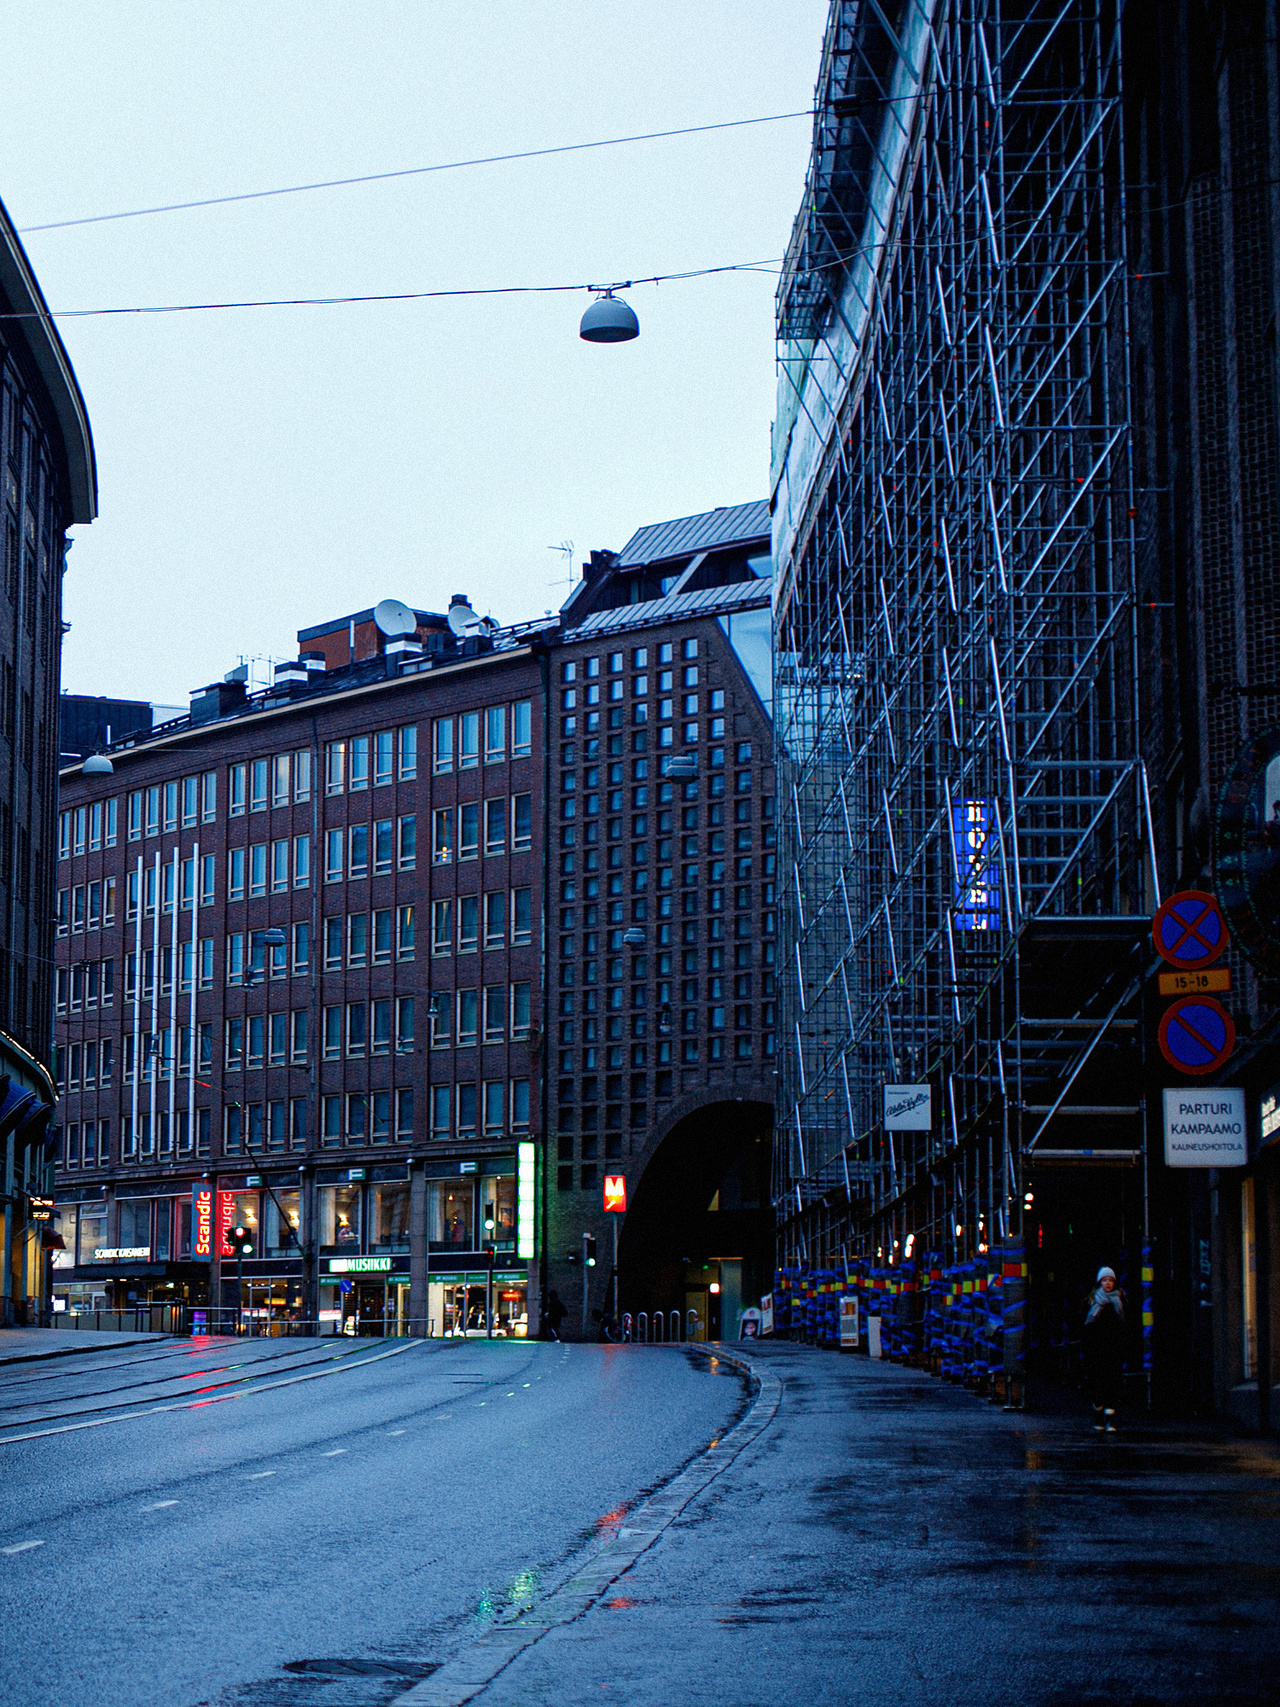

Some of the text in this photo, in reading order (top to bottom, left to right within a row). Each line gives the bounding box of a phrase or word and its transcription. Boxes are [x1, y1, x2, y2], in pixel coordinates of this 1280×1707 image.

[1174, 975, 1210, 988] 15-18
[1179, 1103, 1233, 1115] PARTURI
[1170, 1122, 1242, 1135] KAMPAAMO
[1171, 1143, 1245, 1151] KAUNEUSHOITOLA
[605, 1177, 625, 1197] M
[195, 1190, 212, 1256] Scandic
[347, 1257, 391, 1272] MUSIIKKI
